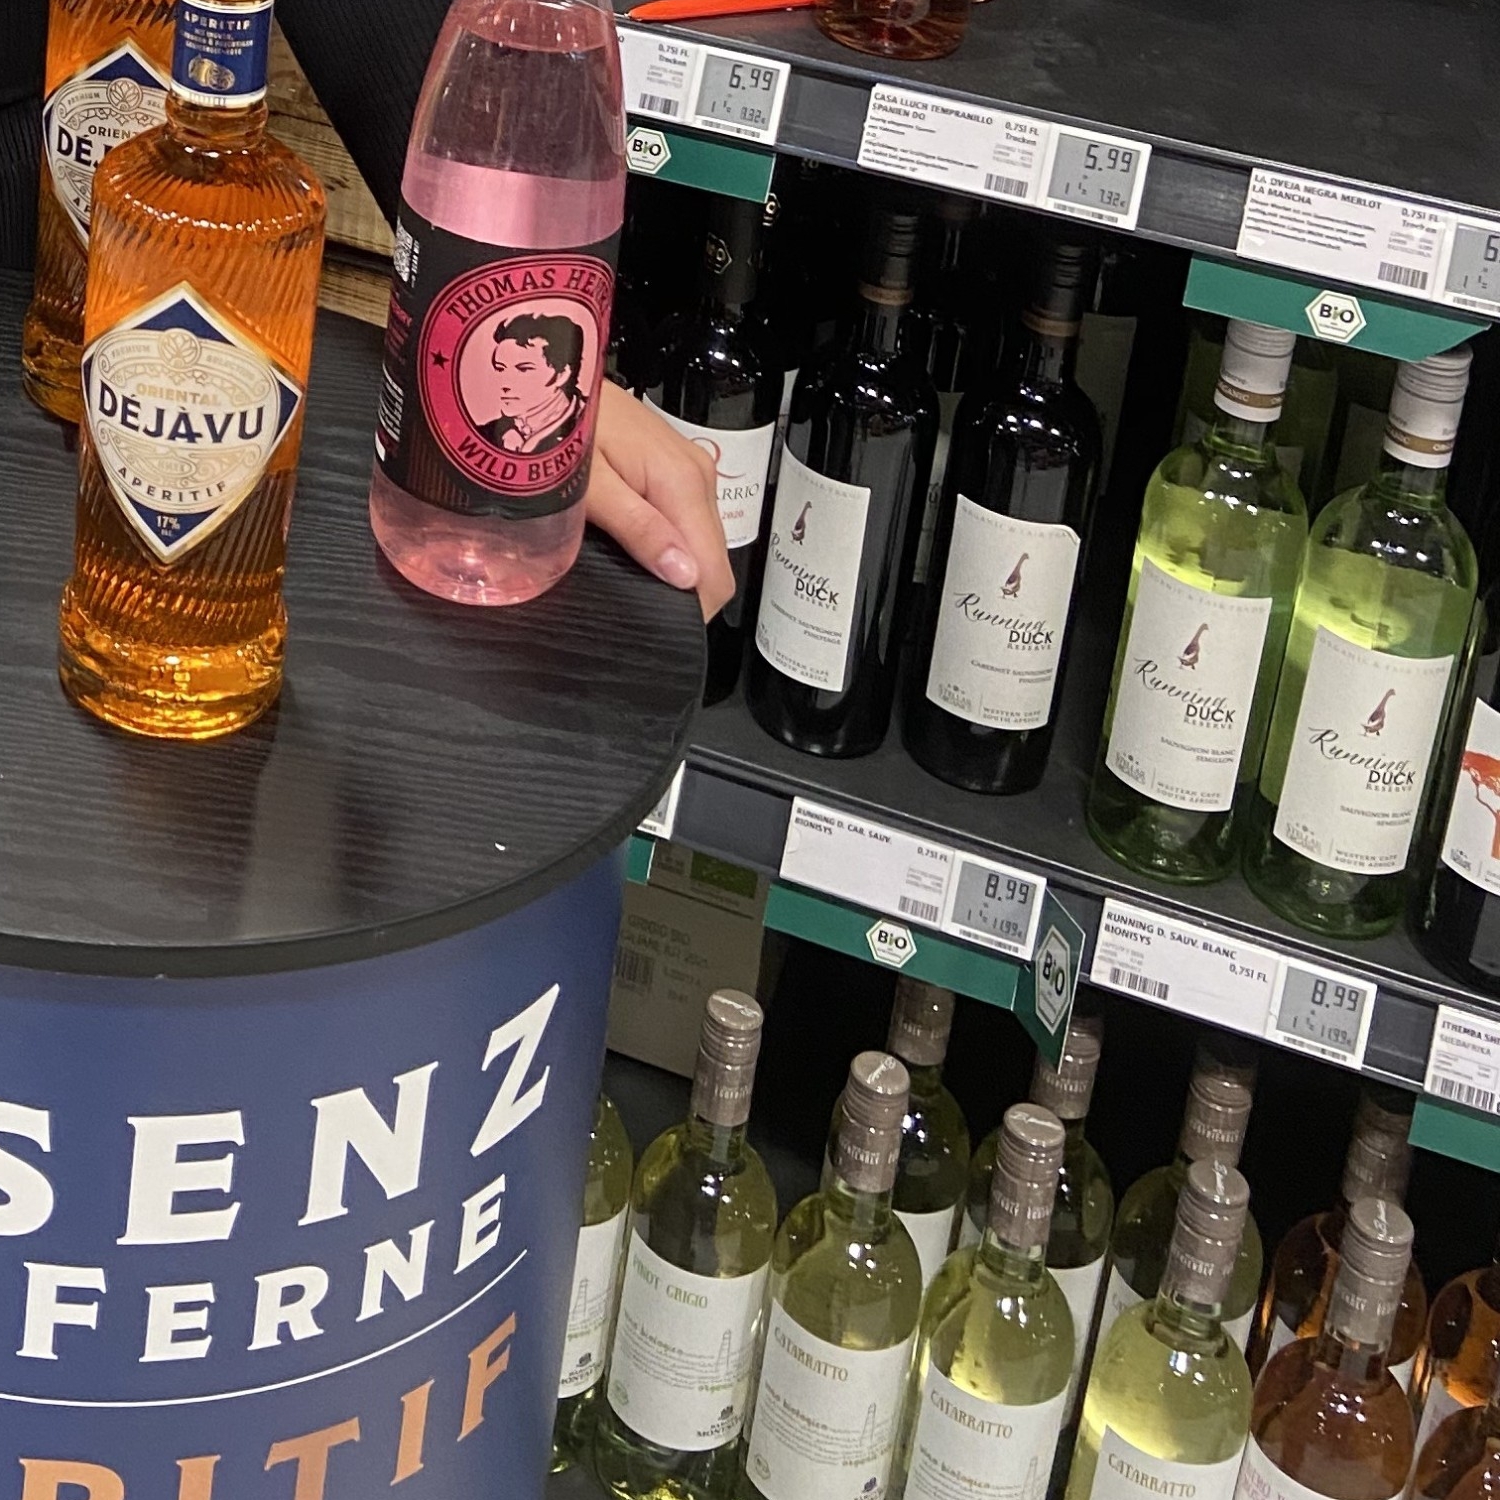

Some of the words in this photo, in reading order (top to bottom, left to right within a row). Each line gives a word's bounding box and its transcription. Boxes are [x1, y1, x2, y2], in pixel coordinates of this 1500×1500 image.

[729, 63, 775, 92] 6.99
[872, 102, 909, 119] SPANIEN
[874, 91, 898, 105] CASA
[900, 97, 928, 111] LLUCH
[1085, 143, 1133, 173] 5.99
[1255, 174, 1267, 185] LA
[1303, 184, 1338, 200] NEGRA
[1340, 193, 1382, 211] MERLOT
[1268, 189, 1312, 206] MANCHA
[445, 267, 557, 325] THOMAS
[136, 382, 221, 406] ORIENTAL
[456, 434, 517, 481] WILD
[527, 430, 585, 482] BERRY
[118, 466, 227, 502] APERITIF
[156, 514, 180, 531] 17%
[770, 532, 832, 590] Running
[795, 577, 840, 605] DUCK
[953, 591, 1047, 634] Running
[1008, 629, 1055, 645] DUCK
[1133, 656, 1230, 712] Running
[1186, 703, 1237, 724] DUCK
[1308, 725, 1410, 775] Running
[1368, 769, 1417, 786] DUCK
[794, 816, 833, 837] BIONISYS
[796, 807, 835, 828] RUNNING
[985, 873, 1030, 905] 8.99
[1103, 923, 1152, 947] BIONISYS
[1106, 910, 1155, 936] RUNNING
[1170, 930, 1200, 948] SAUV.
[1202, 940, 1238, 961] BLANC
[1311, 979, 1360, 1013] 8.99
[16, 1172, 507, 1364] FERNE
[632, 1253, 660, 1291] PINOT
[666, 1284, 709, 1310] GRIGIO
[774, 1325, 850, 1383] CATARRATTO
[931, 1388, 1014, 1440] CATARRATTO
[1107, 1452, 1198, 1500] CATARRATTO
